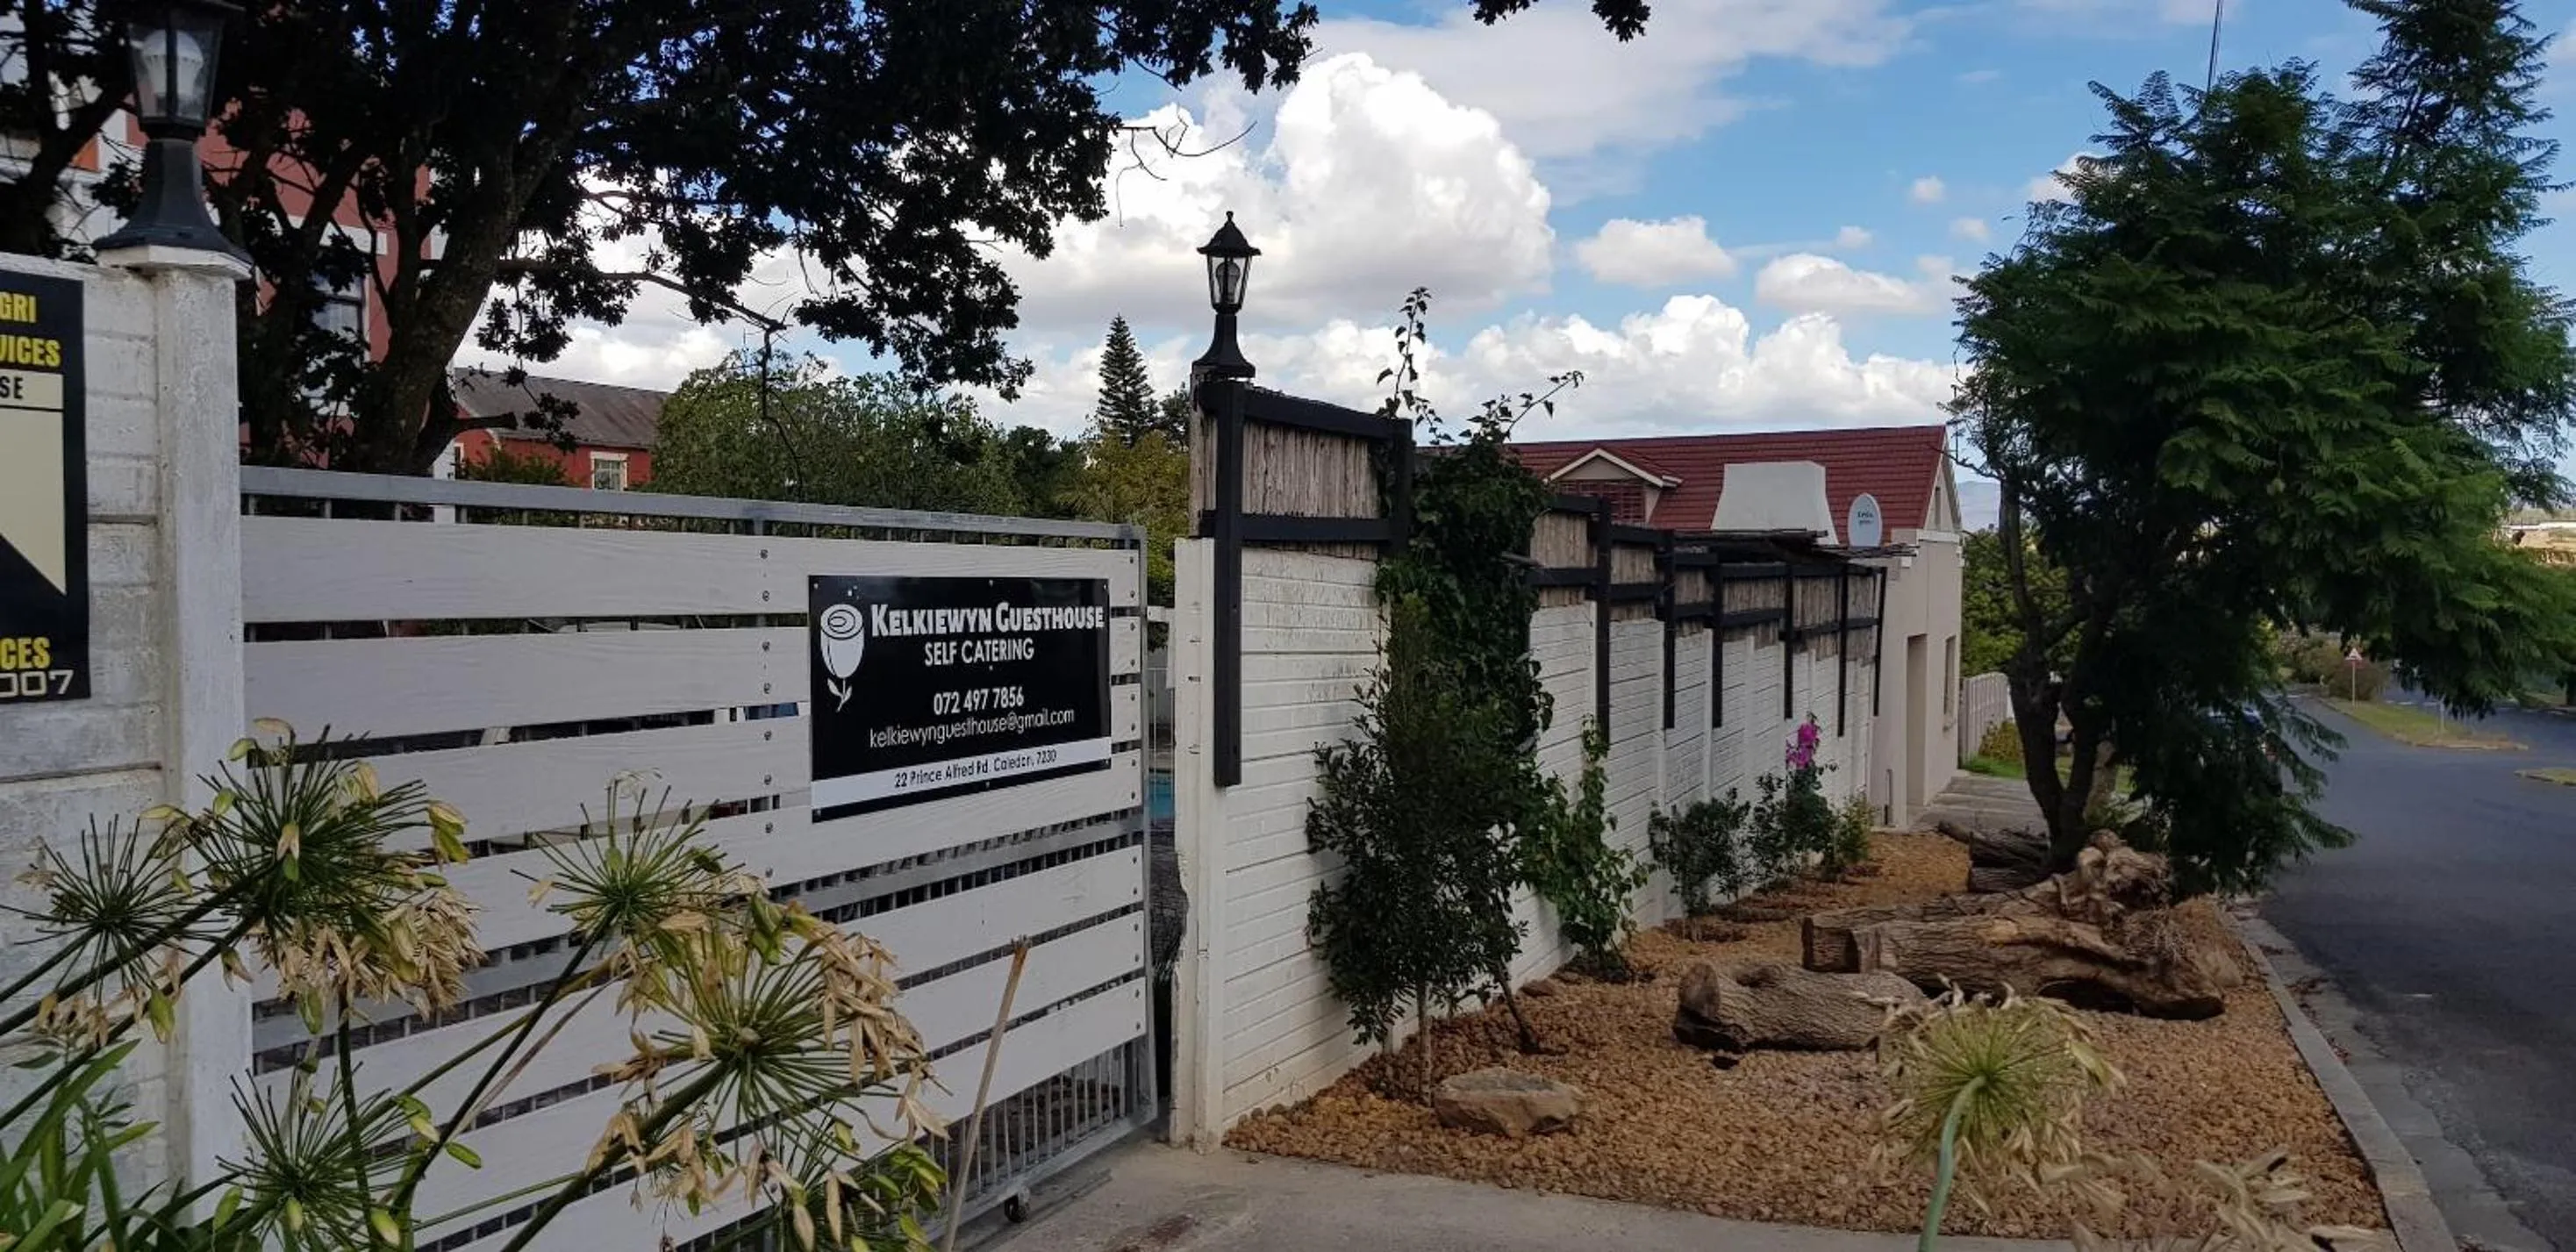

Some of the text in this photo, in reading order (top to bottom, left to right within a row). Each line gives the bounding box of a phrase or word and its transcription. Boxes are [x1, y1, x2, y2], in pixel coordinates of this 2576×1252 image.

[870, 601, 1105, 637] KELKIEWYN GUESTHOUSE
[924, 638, 1035, 667] SELF CATERING
[933, 685, 1025, 716] 072 497 7856
[869, 707, 1075, 748] kelkiewynguesthouse@gmail.com
[894, 772, 908, 788] 22
[910, 768, 942, 785] Prince
[946, 762, 975, 778] Alfred
[1036, 748, 1057, 765] 7230
